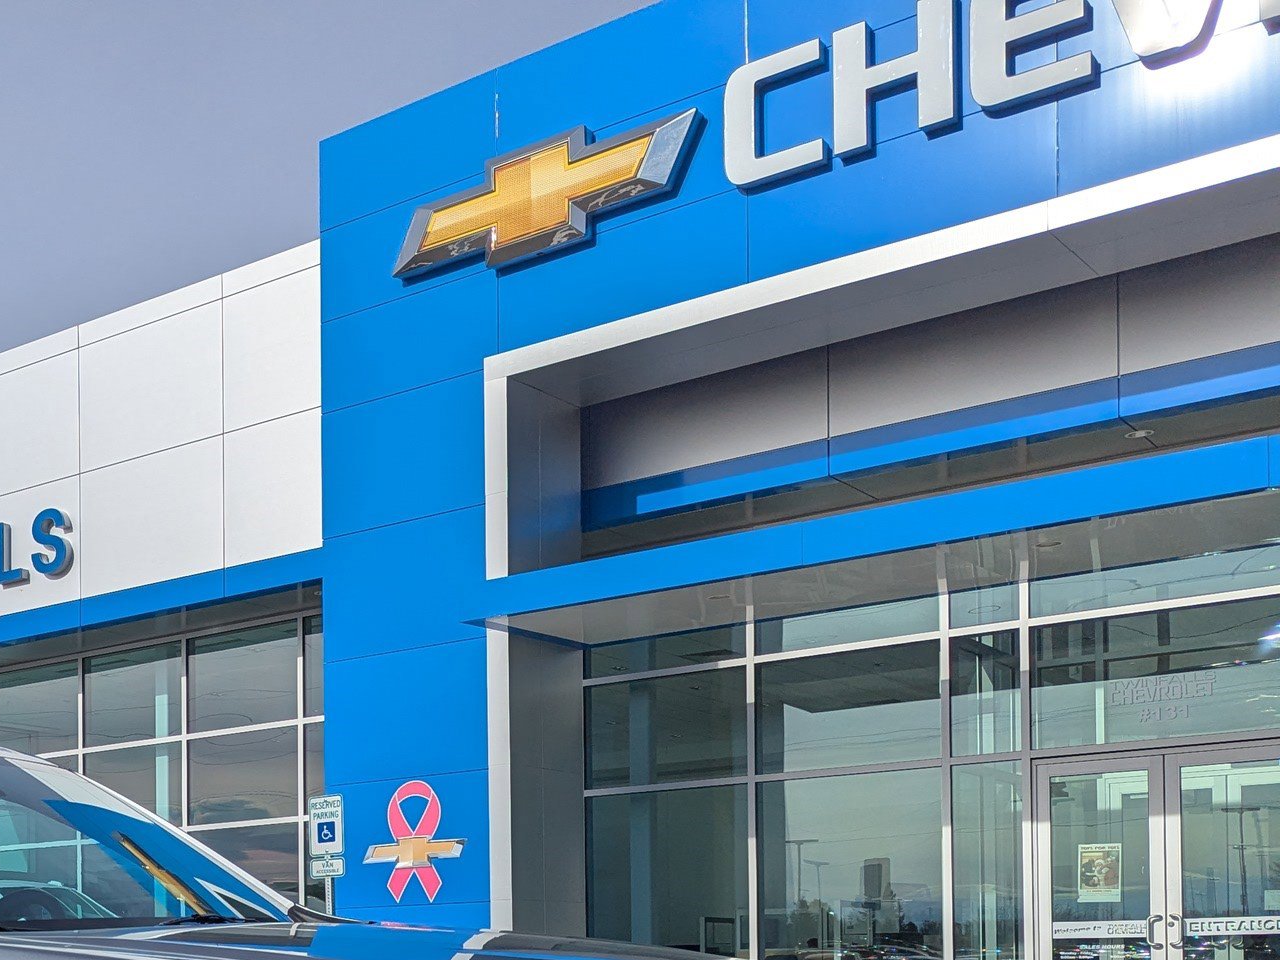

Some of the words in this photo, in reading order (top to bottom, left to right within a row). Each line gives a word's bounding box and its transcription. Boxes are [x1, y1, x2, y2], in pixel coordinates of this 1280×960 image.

[723, 0, 1280, 192] CHE
[1110, 679, 1217, 706] CHEVROLET
[1140, 704, 1189, 723] #131
[310, 799, 341, 809] RESERVED
[313, 810, 339, 819] PARKING
